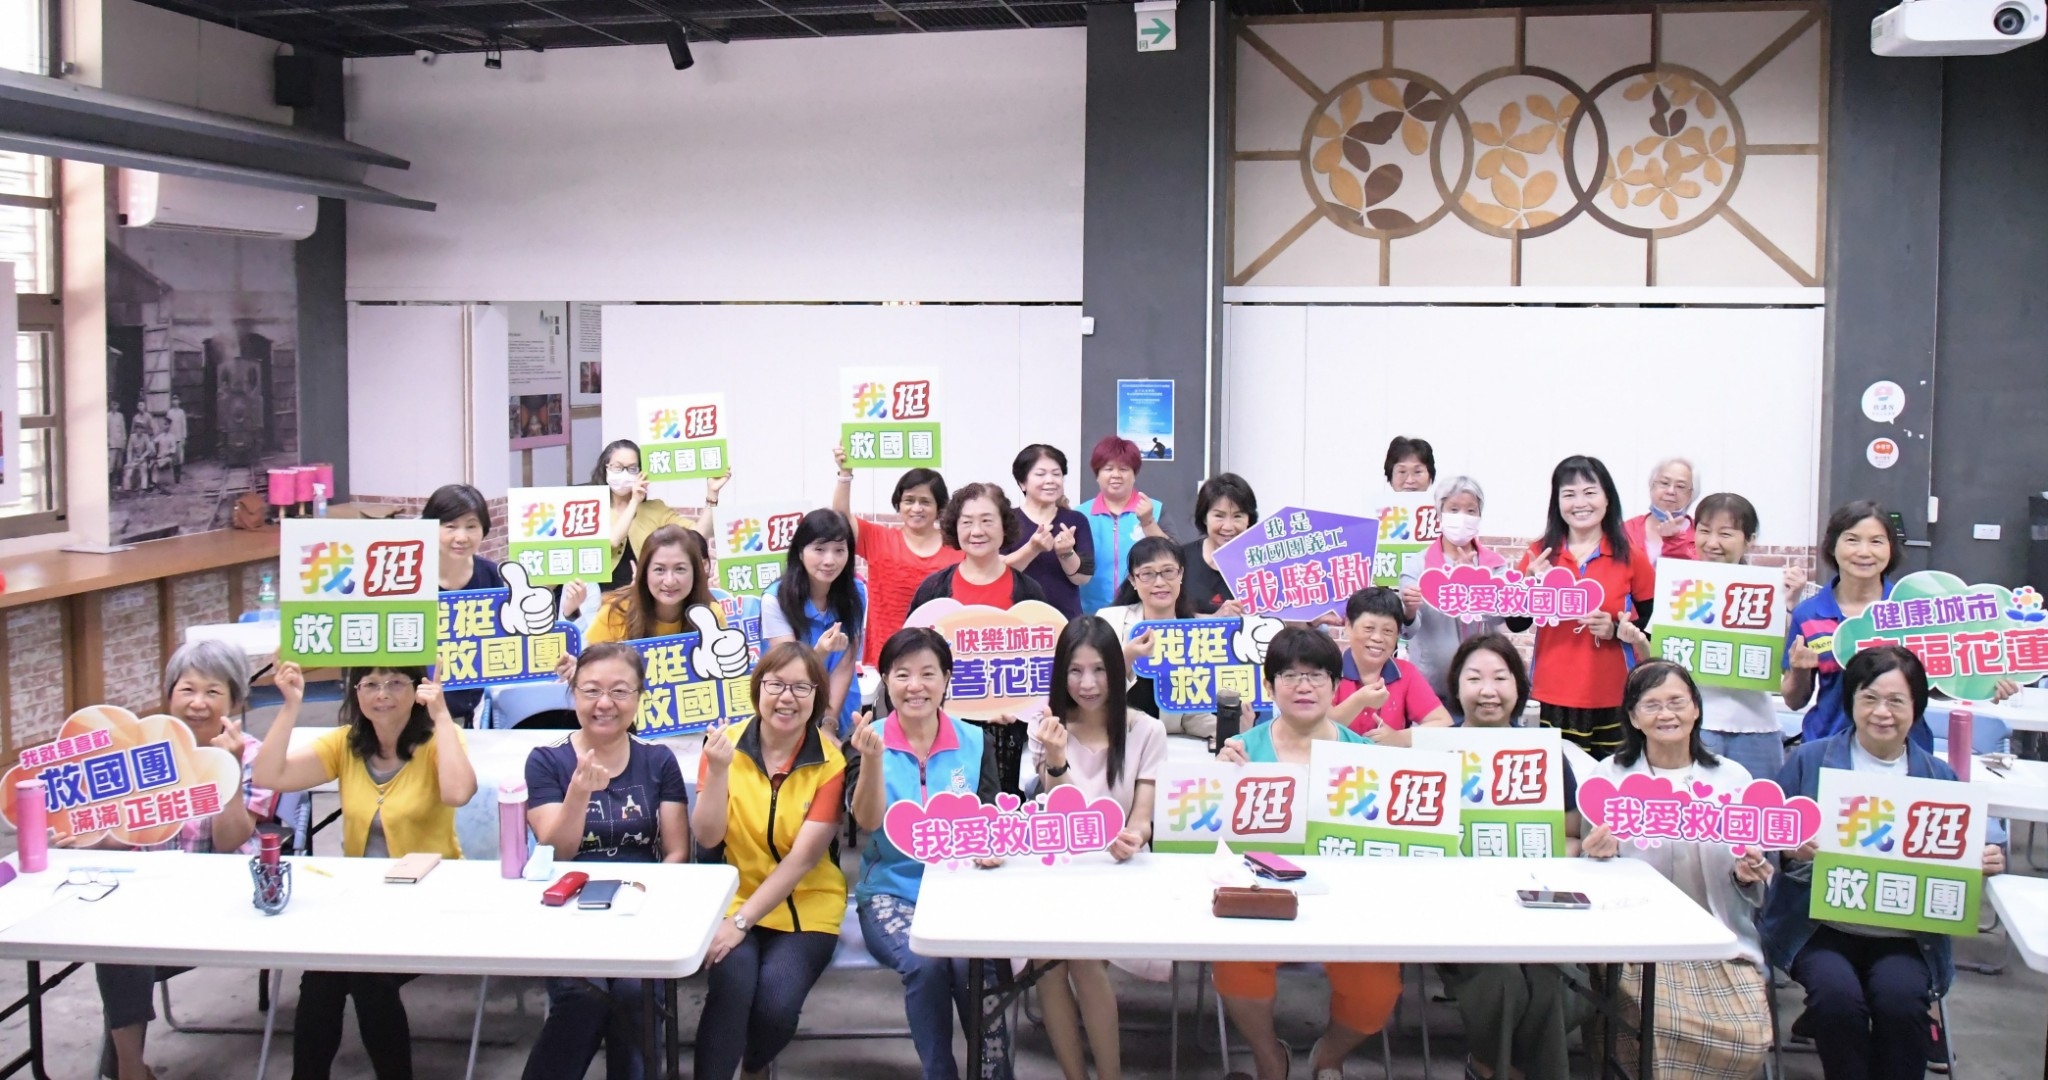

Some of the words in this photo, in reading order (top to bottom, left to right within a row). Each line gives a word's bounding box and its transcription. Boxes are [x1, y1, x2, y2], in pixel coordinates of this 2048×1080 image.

[852, 380, 931, 421] 我挺
[649, 404, 718, 440] 我挺
[648, 445, 722, 474] 救國團
[849, 430, 933, 460] 救國團
[521, 499, 600, 539] 我挺
[1265, 511, 1312, 539] 我是
[517, 545, 604, 578] 救國團
[1245, 527, 1348, 568] 救國團義工
[299, 540, 424, 597] 我挺
[1236, 551, 1373, 616] 我驕傲
[1438, 583, 1590, 618] 我愛救國團
[1670, 578, 1775, 631] 我挺
[1872, 593, 1999, 630] 健康城市
[292, 612, 426, 655] 救國團
[955, 625, 1054, 653] 快樂城市
[1150, 627, 1229, 665] 我挺
[1662, 635, 1774, 681] 救國團
[1170, 666, 1274, 706] 救國
[20, 729, 112, 769] 我就是喜歡
[38, 741, 180, 811] 救國團
[1328, 764, 1446, 827] 我挺
[1167, 775, 1296, 836] 我挺
[1604, 795, 1803, 847] 我愛救國團
[911, 811, 1107, 860] 我愛救國團
[1836, 794, 1972, 860] 我挺
[1825, 866, 1969, 923] 救國團
